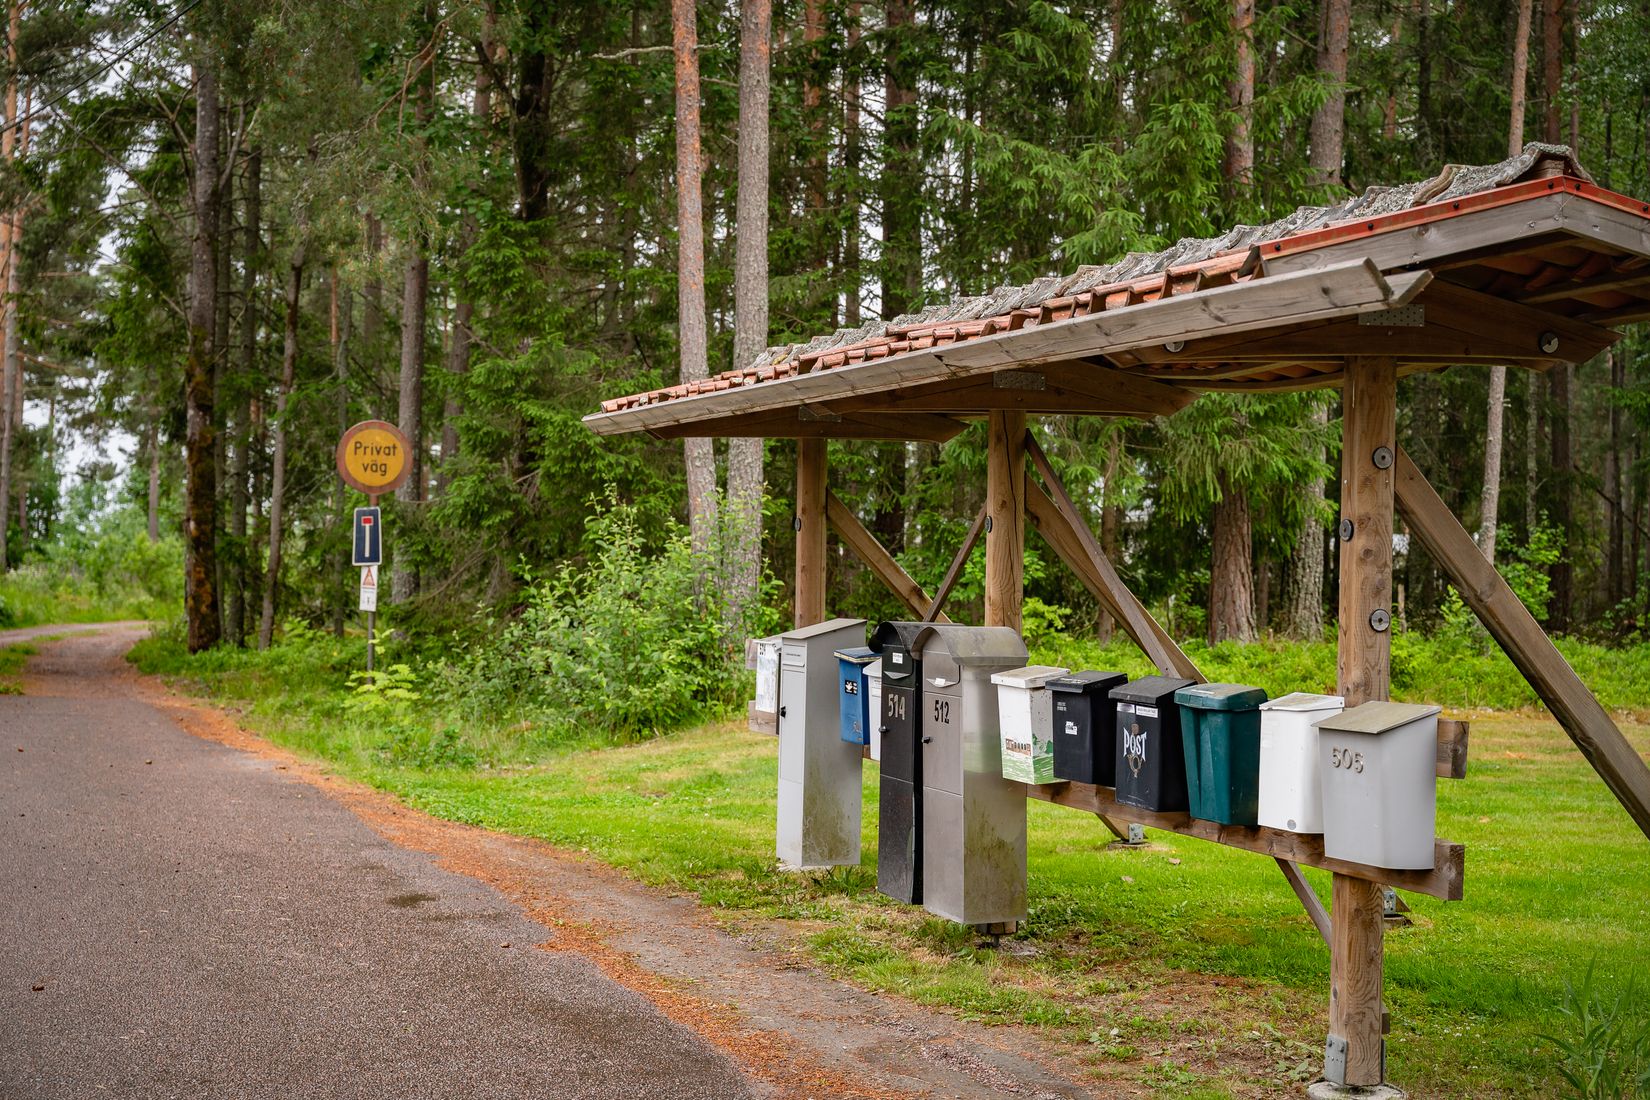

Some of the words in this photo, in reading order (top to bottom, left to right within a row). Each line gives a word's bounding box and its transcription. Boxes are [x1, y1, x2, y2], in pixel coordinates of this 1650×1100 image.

[354, 441, 397, 456] Privat
[362, 460, 387, 476] väg
[888, 694, 906, 720] 514
[934, 700, 950, 724] 512
[1123, 727, 1147, 762] POST
[1332, 746, 1364, 774] 505
